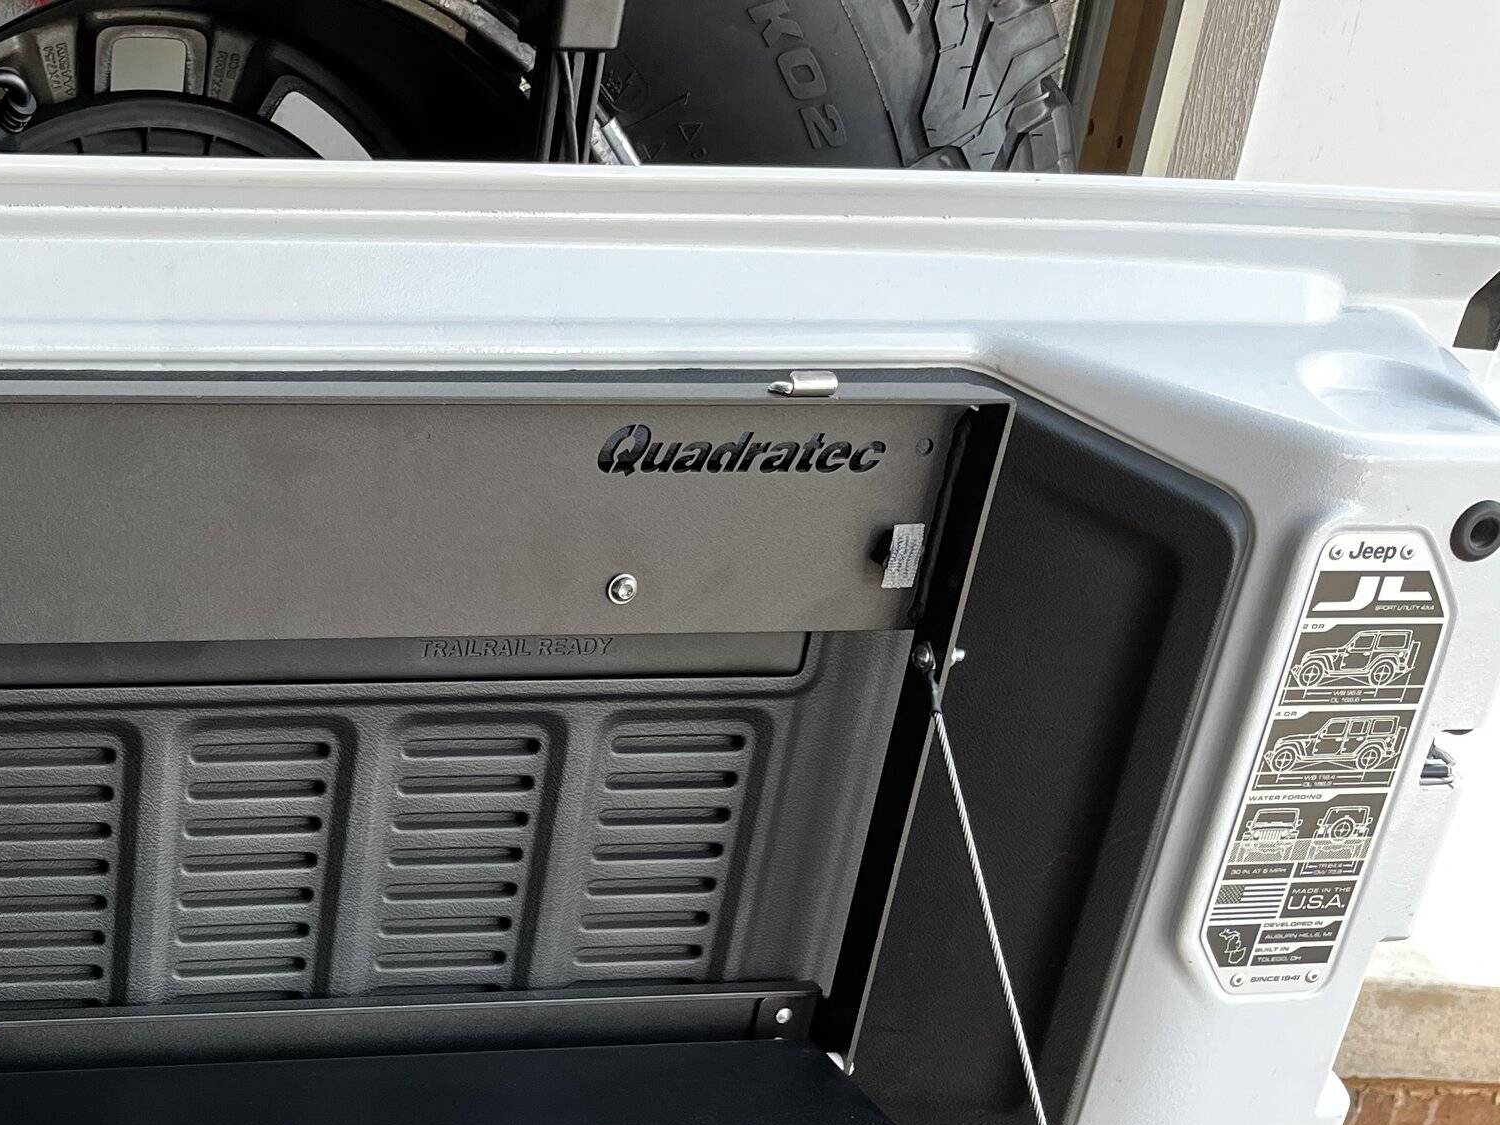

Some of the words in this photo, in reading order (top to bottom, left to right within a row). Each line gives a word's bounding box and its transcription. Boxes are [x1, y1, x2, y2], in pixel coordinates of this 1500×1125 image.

[597, 423, 887, 477] Quadratec
[1348, 541, 1397, 563] Jeep
[1311, 575, 1433, 612] JL
[420, 638, 532, 658] TRAILRAIL
[538, 637, 613, 656] READY
[1287, 894, 1345, 910] U.S.A.
[1280, 974, 1301, 982] 1941
